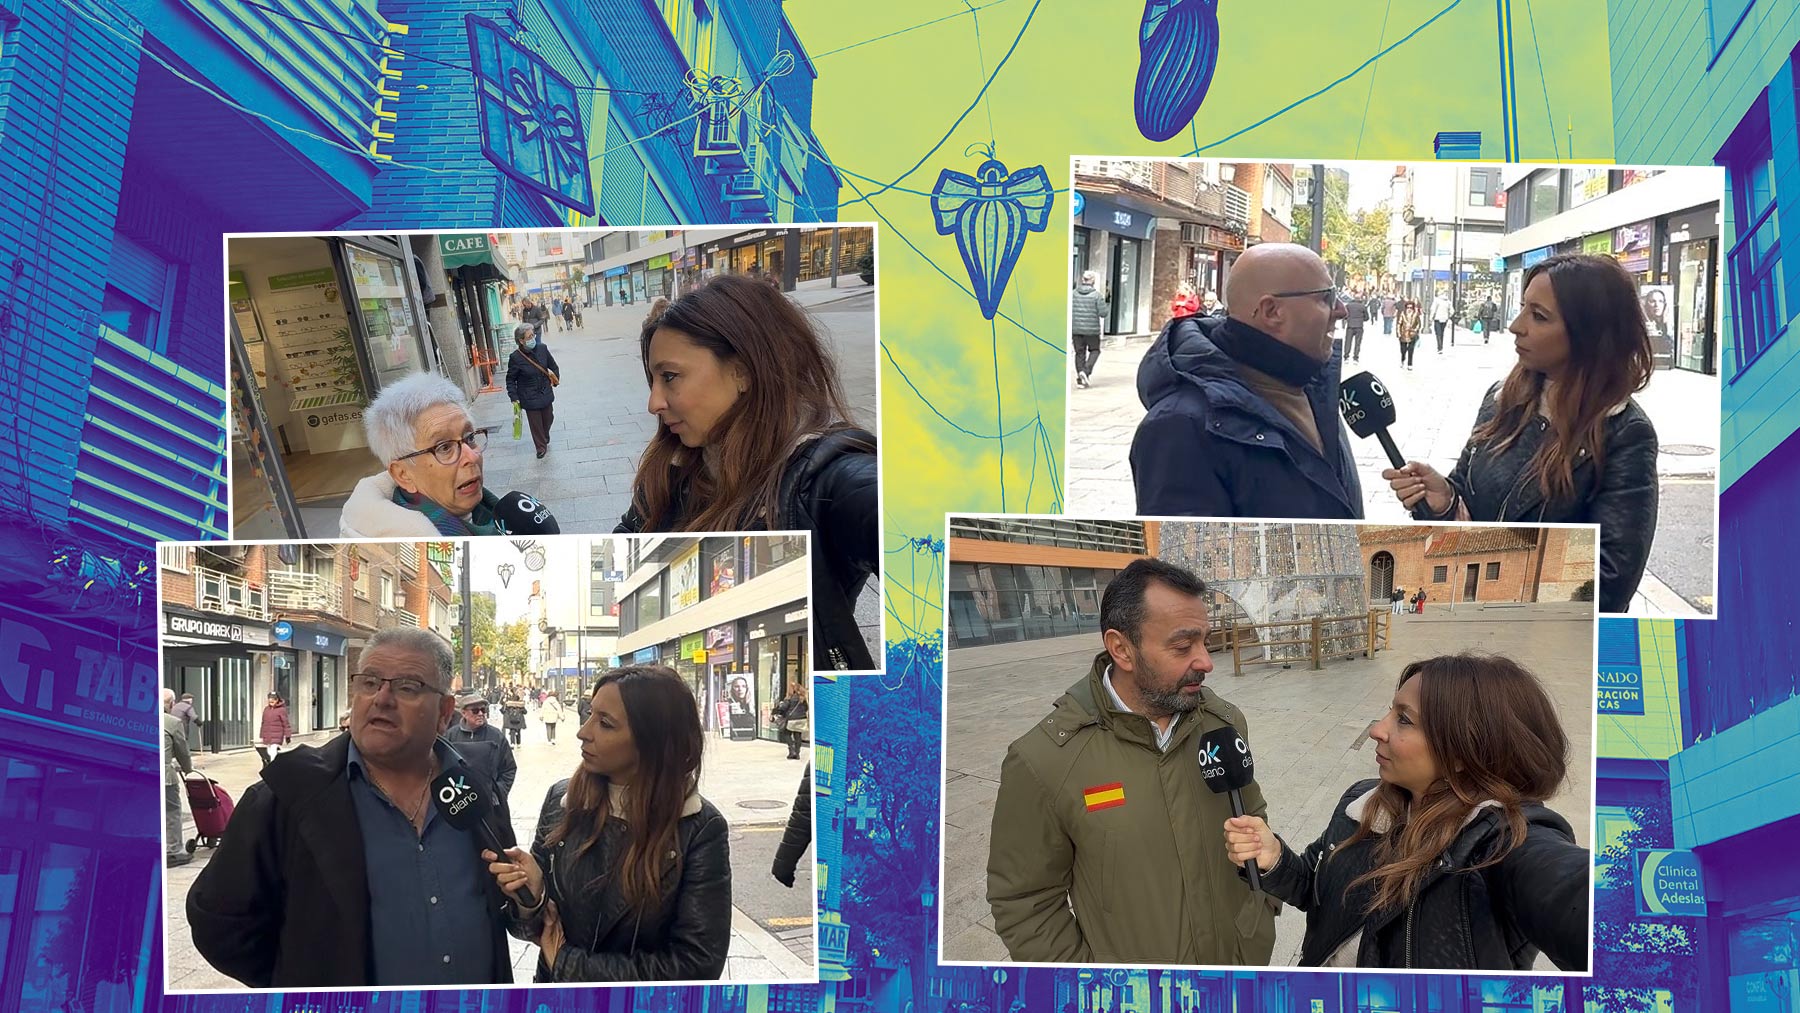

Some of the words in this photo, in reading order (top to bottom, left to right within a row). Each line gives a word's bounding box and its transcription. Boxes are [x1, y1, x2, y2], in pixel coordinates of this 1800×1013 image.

[444, 236, 484, 251] CAFE
[321, 411, 363, 426] gafas.es
[171, 617, 203, 633] GRUPO
[203, 623, 231, 638] DAREK
[74, 645, 158, 713] TAB
[1597, 690, 1639, 700] RACIÓN
[1599, 700, 1620, 709] CAS
[83, 709, 126, 727] ESTANCO
[127, 720, 158, 734] CENTE
[449, 792, 478, 815] diario
[1658, 865, 1697, 877] Clínica
[1659, 879, 1699, 890] Dental
[1661, 891, 1705, 904] Adeslas
